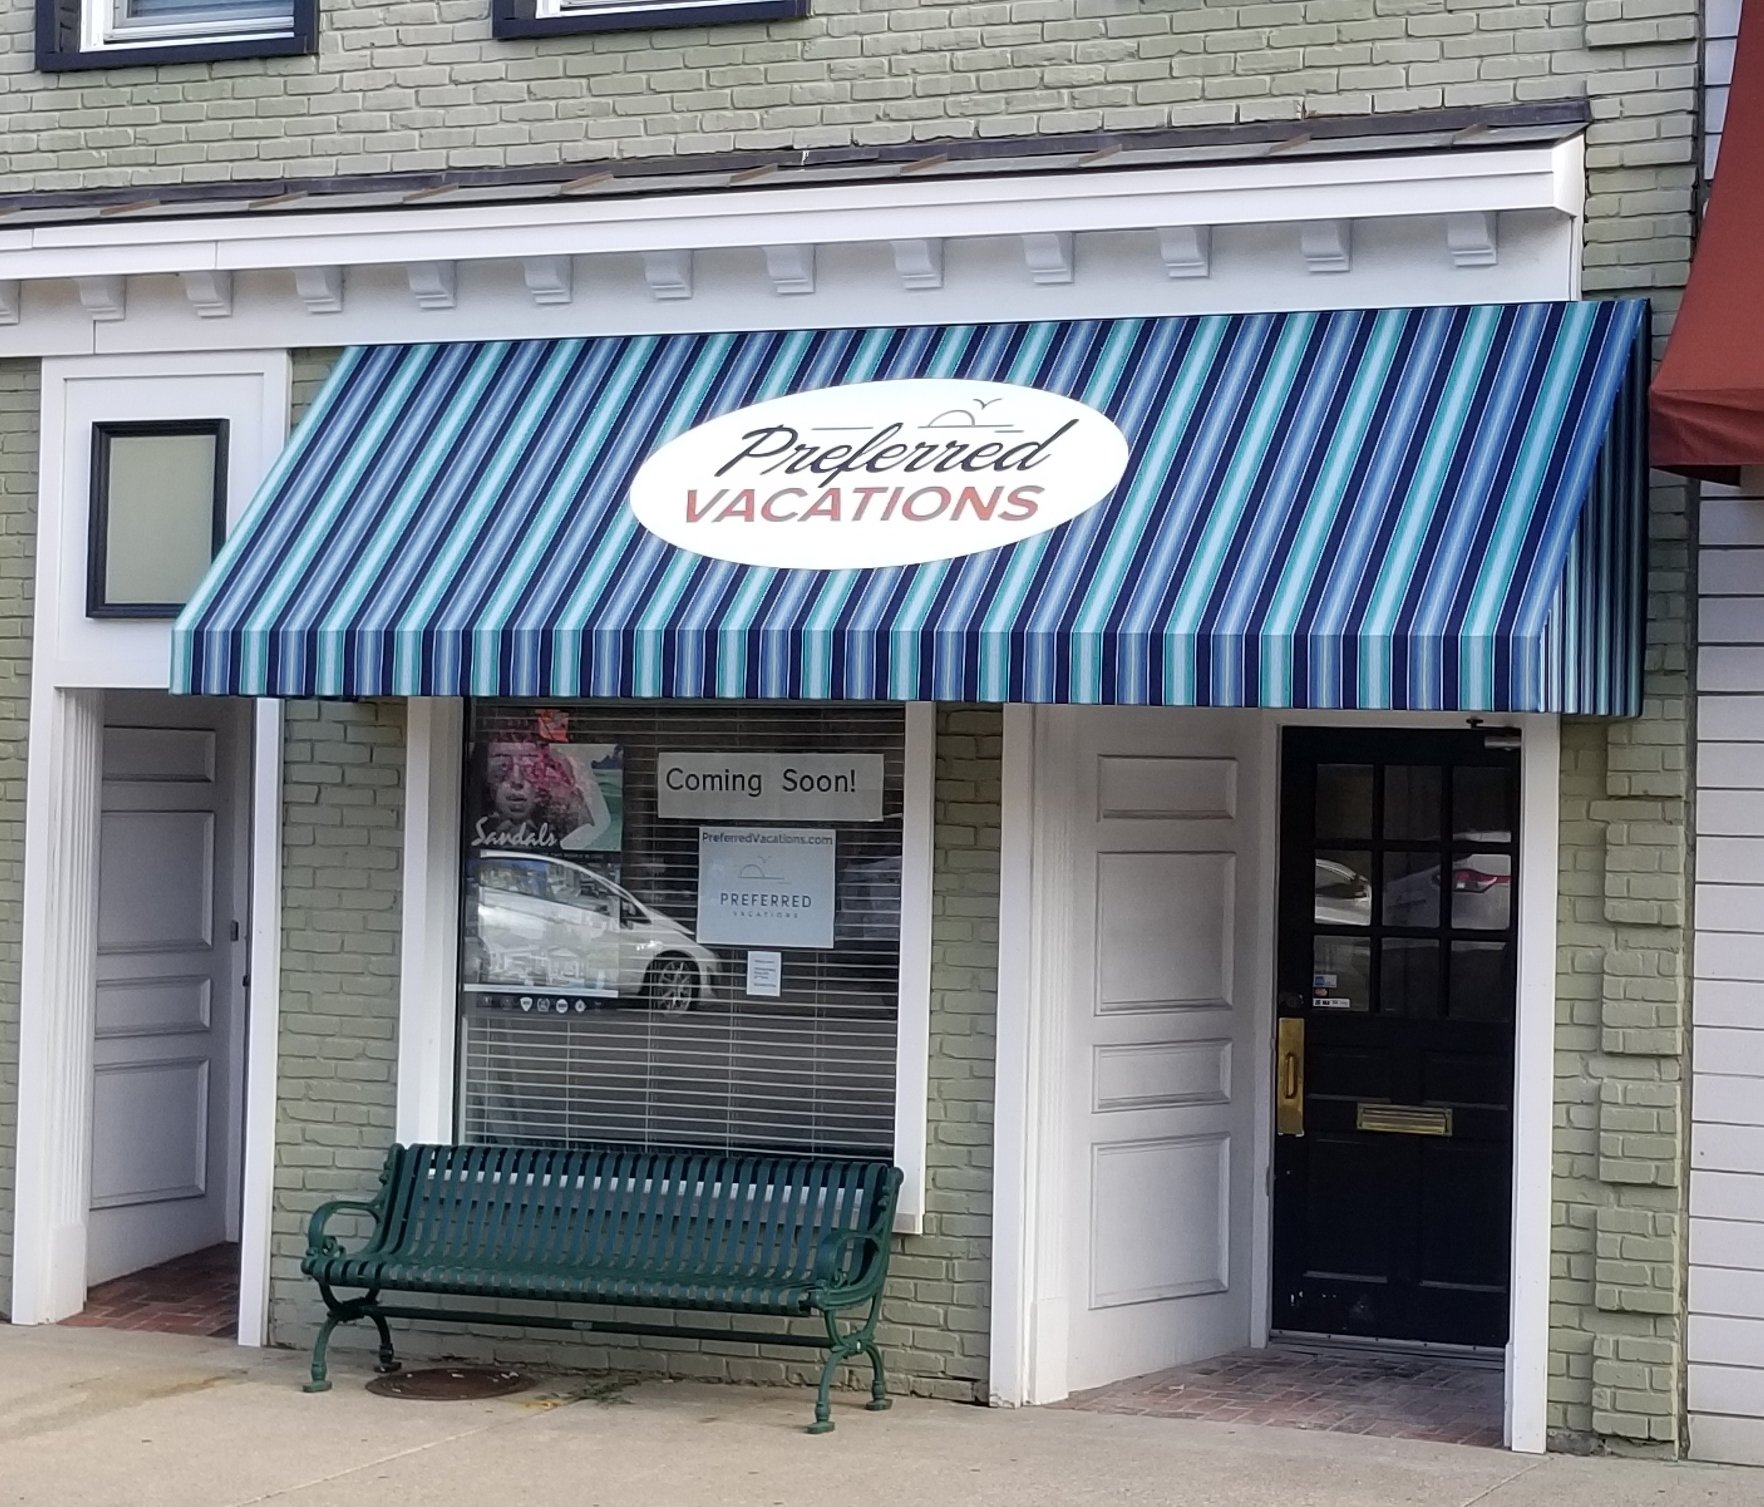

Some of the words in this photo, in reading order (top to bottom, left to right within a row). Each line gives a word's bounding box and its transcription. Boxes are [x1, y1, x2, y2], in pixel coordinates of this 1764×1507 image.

[714, 418, 1080, 489] Preferred
[685, 485, 1046, 523] VACATIONS
[666, 767, 762, 797] Coming
[782, 768, 856, 792] Soon!
[471, 816, 557, 846] Sandals
[702, 832, 833, 845] PreferredVacations.com
[720, 892, 812, 908] PREFERRED
